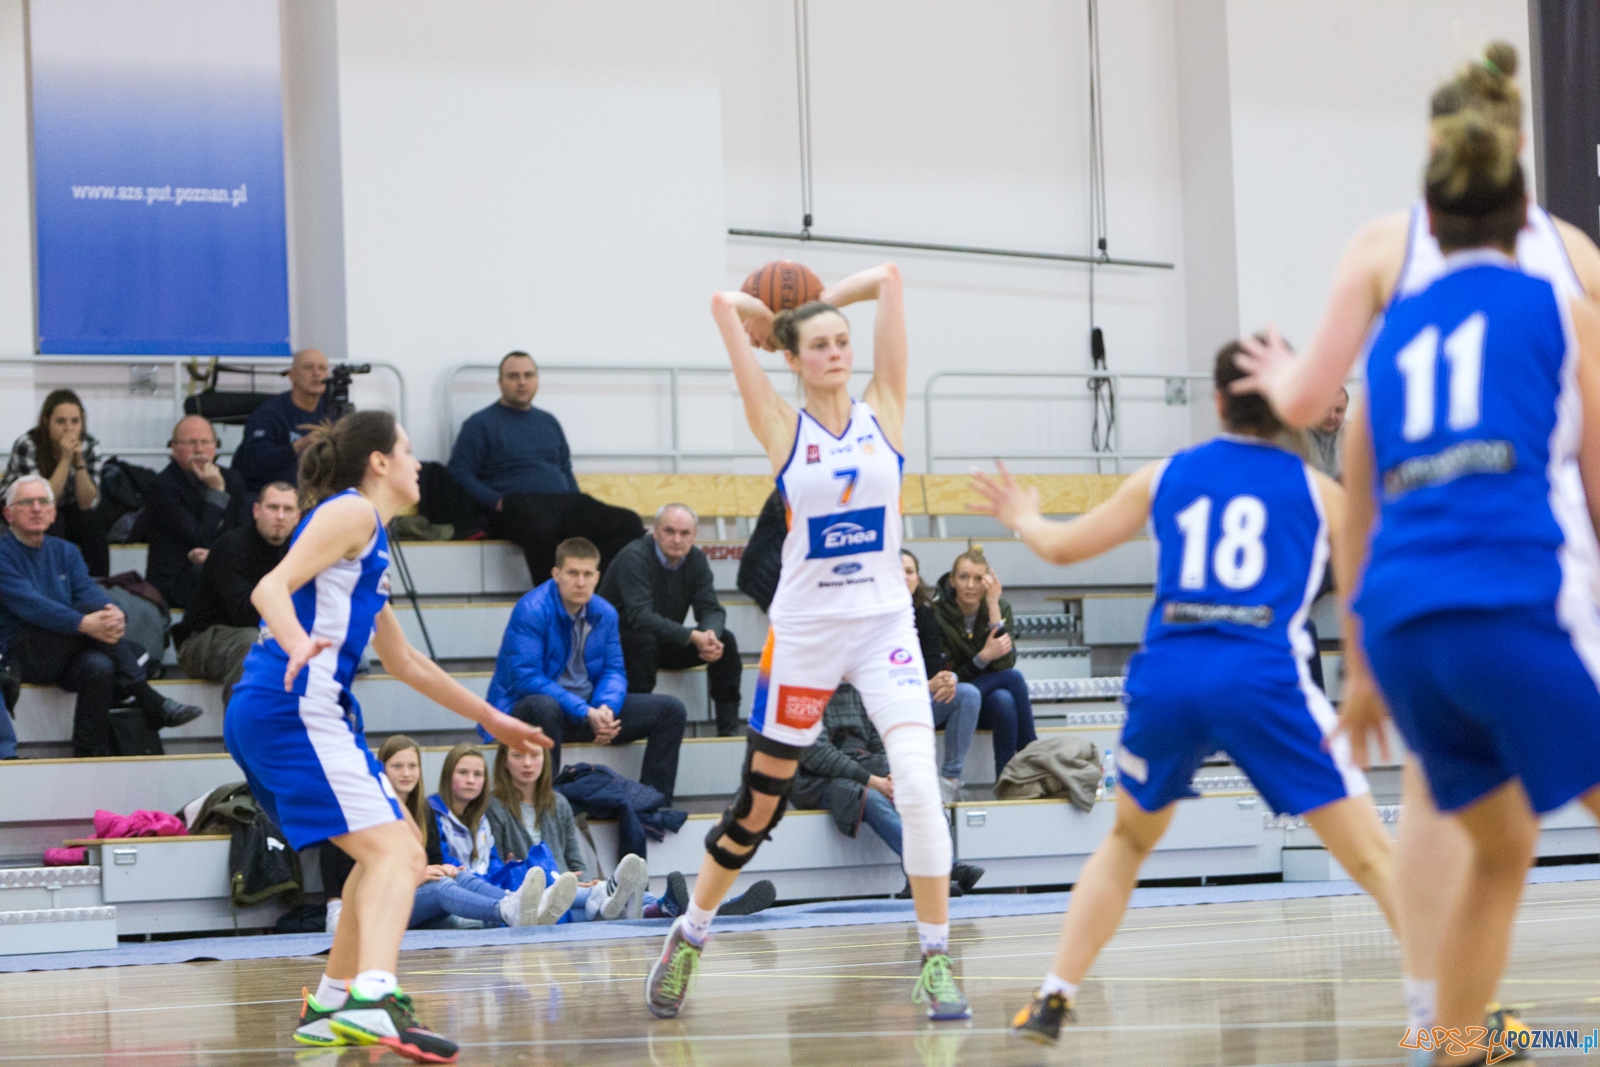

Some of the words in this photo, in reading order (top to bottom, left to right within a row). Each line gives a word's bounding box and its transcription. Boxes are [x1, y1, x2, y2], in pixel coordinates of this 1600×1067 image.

[72, 184, 248, 207] www.azs.put.poznan.pl
[1394, 310, 1489, 443] 11
[834, 469, 858, 506] 7
[824, 530, 877, 548] Enea
[1175, 493, 1268, 591] 18
